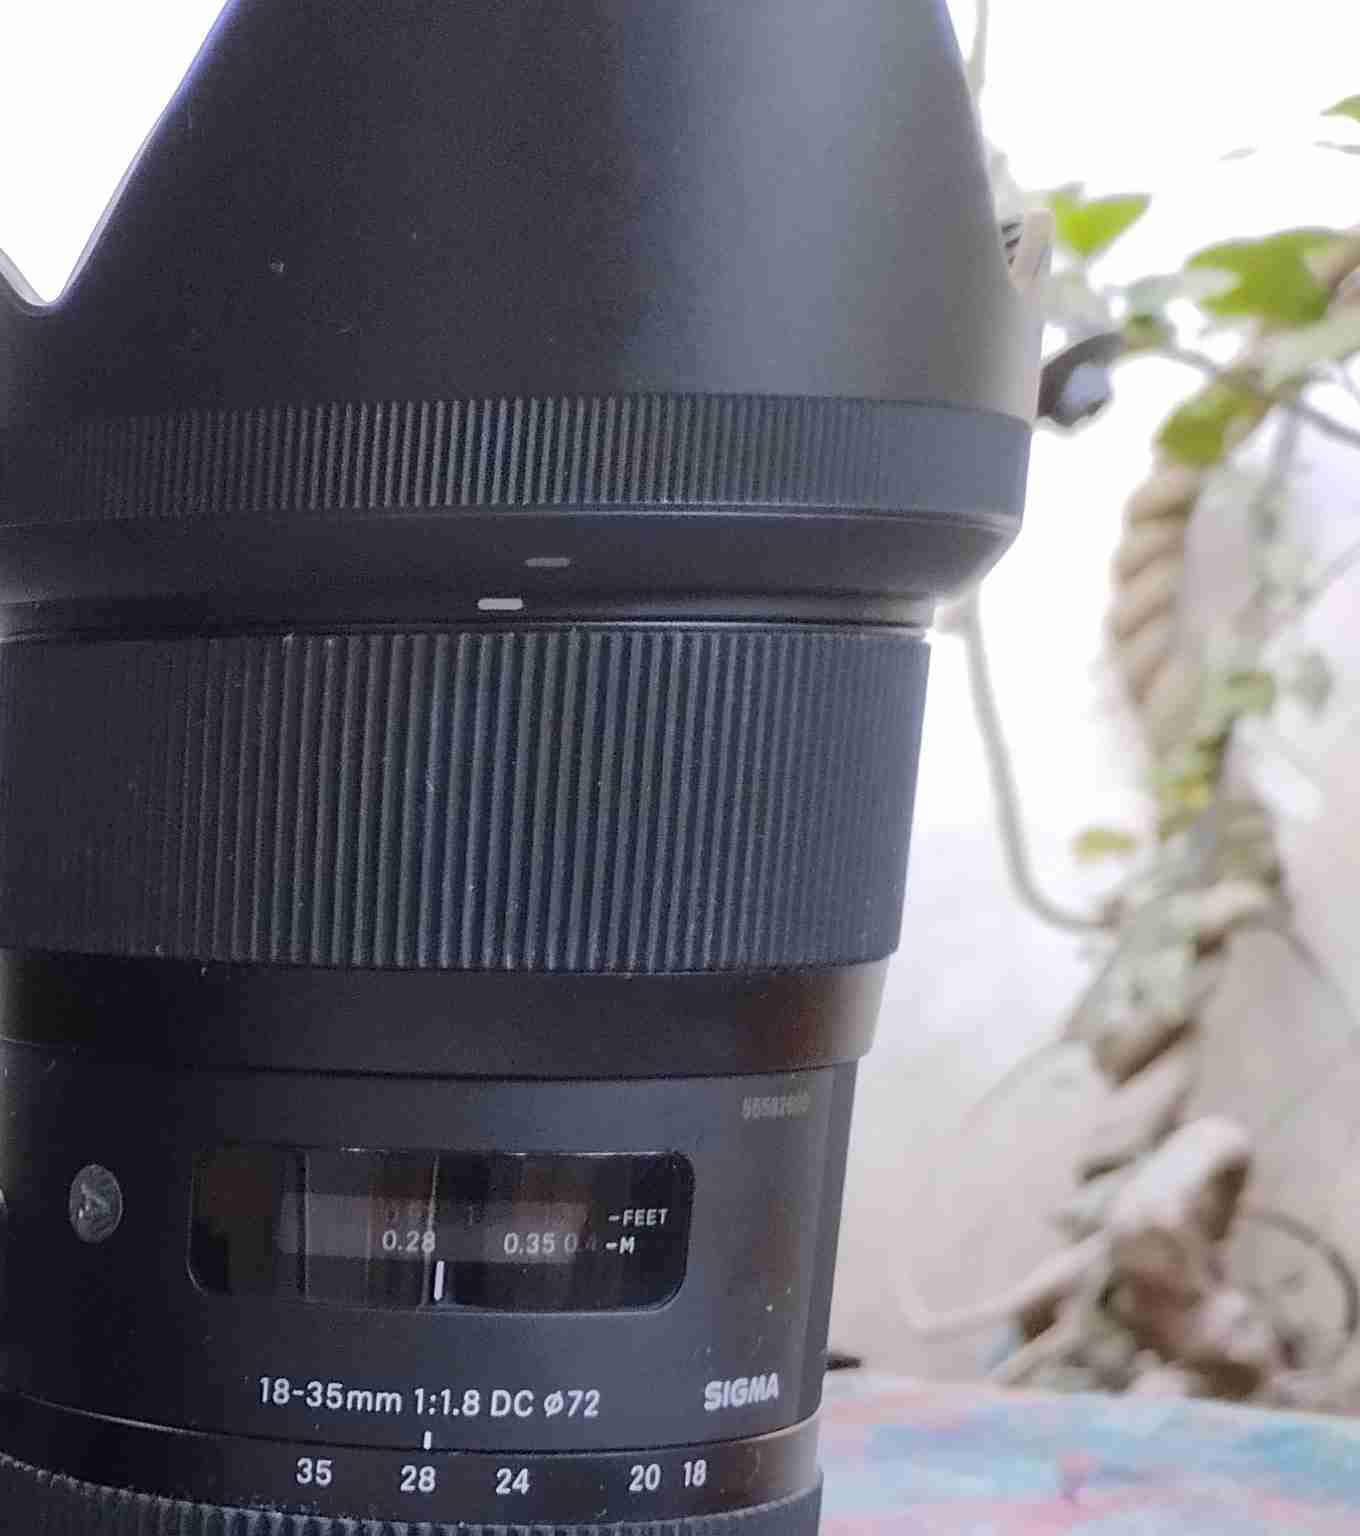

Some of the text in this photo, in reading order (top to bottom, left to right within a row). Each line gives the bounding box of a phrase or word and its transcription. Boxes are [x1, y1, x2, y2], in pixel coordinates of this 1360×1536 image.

[381, 1230, 437, 1253] 0.28
[503, 1232, 556, 1255] 0.35
[259, 1376, 403, 1414] 18-35mm
[414, 1387, 481, 1417] 1:1.8
[489, 1389, 535, 1417] DC
[703, 1372, 780, 1412] SIGMA
[295, 1457, 708, 1495] 35 28 24 20 18
